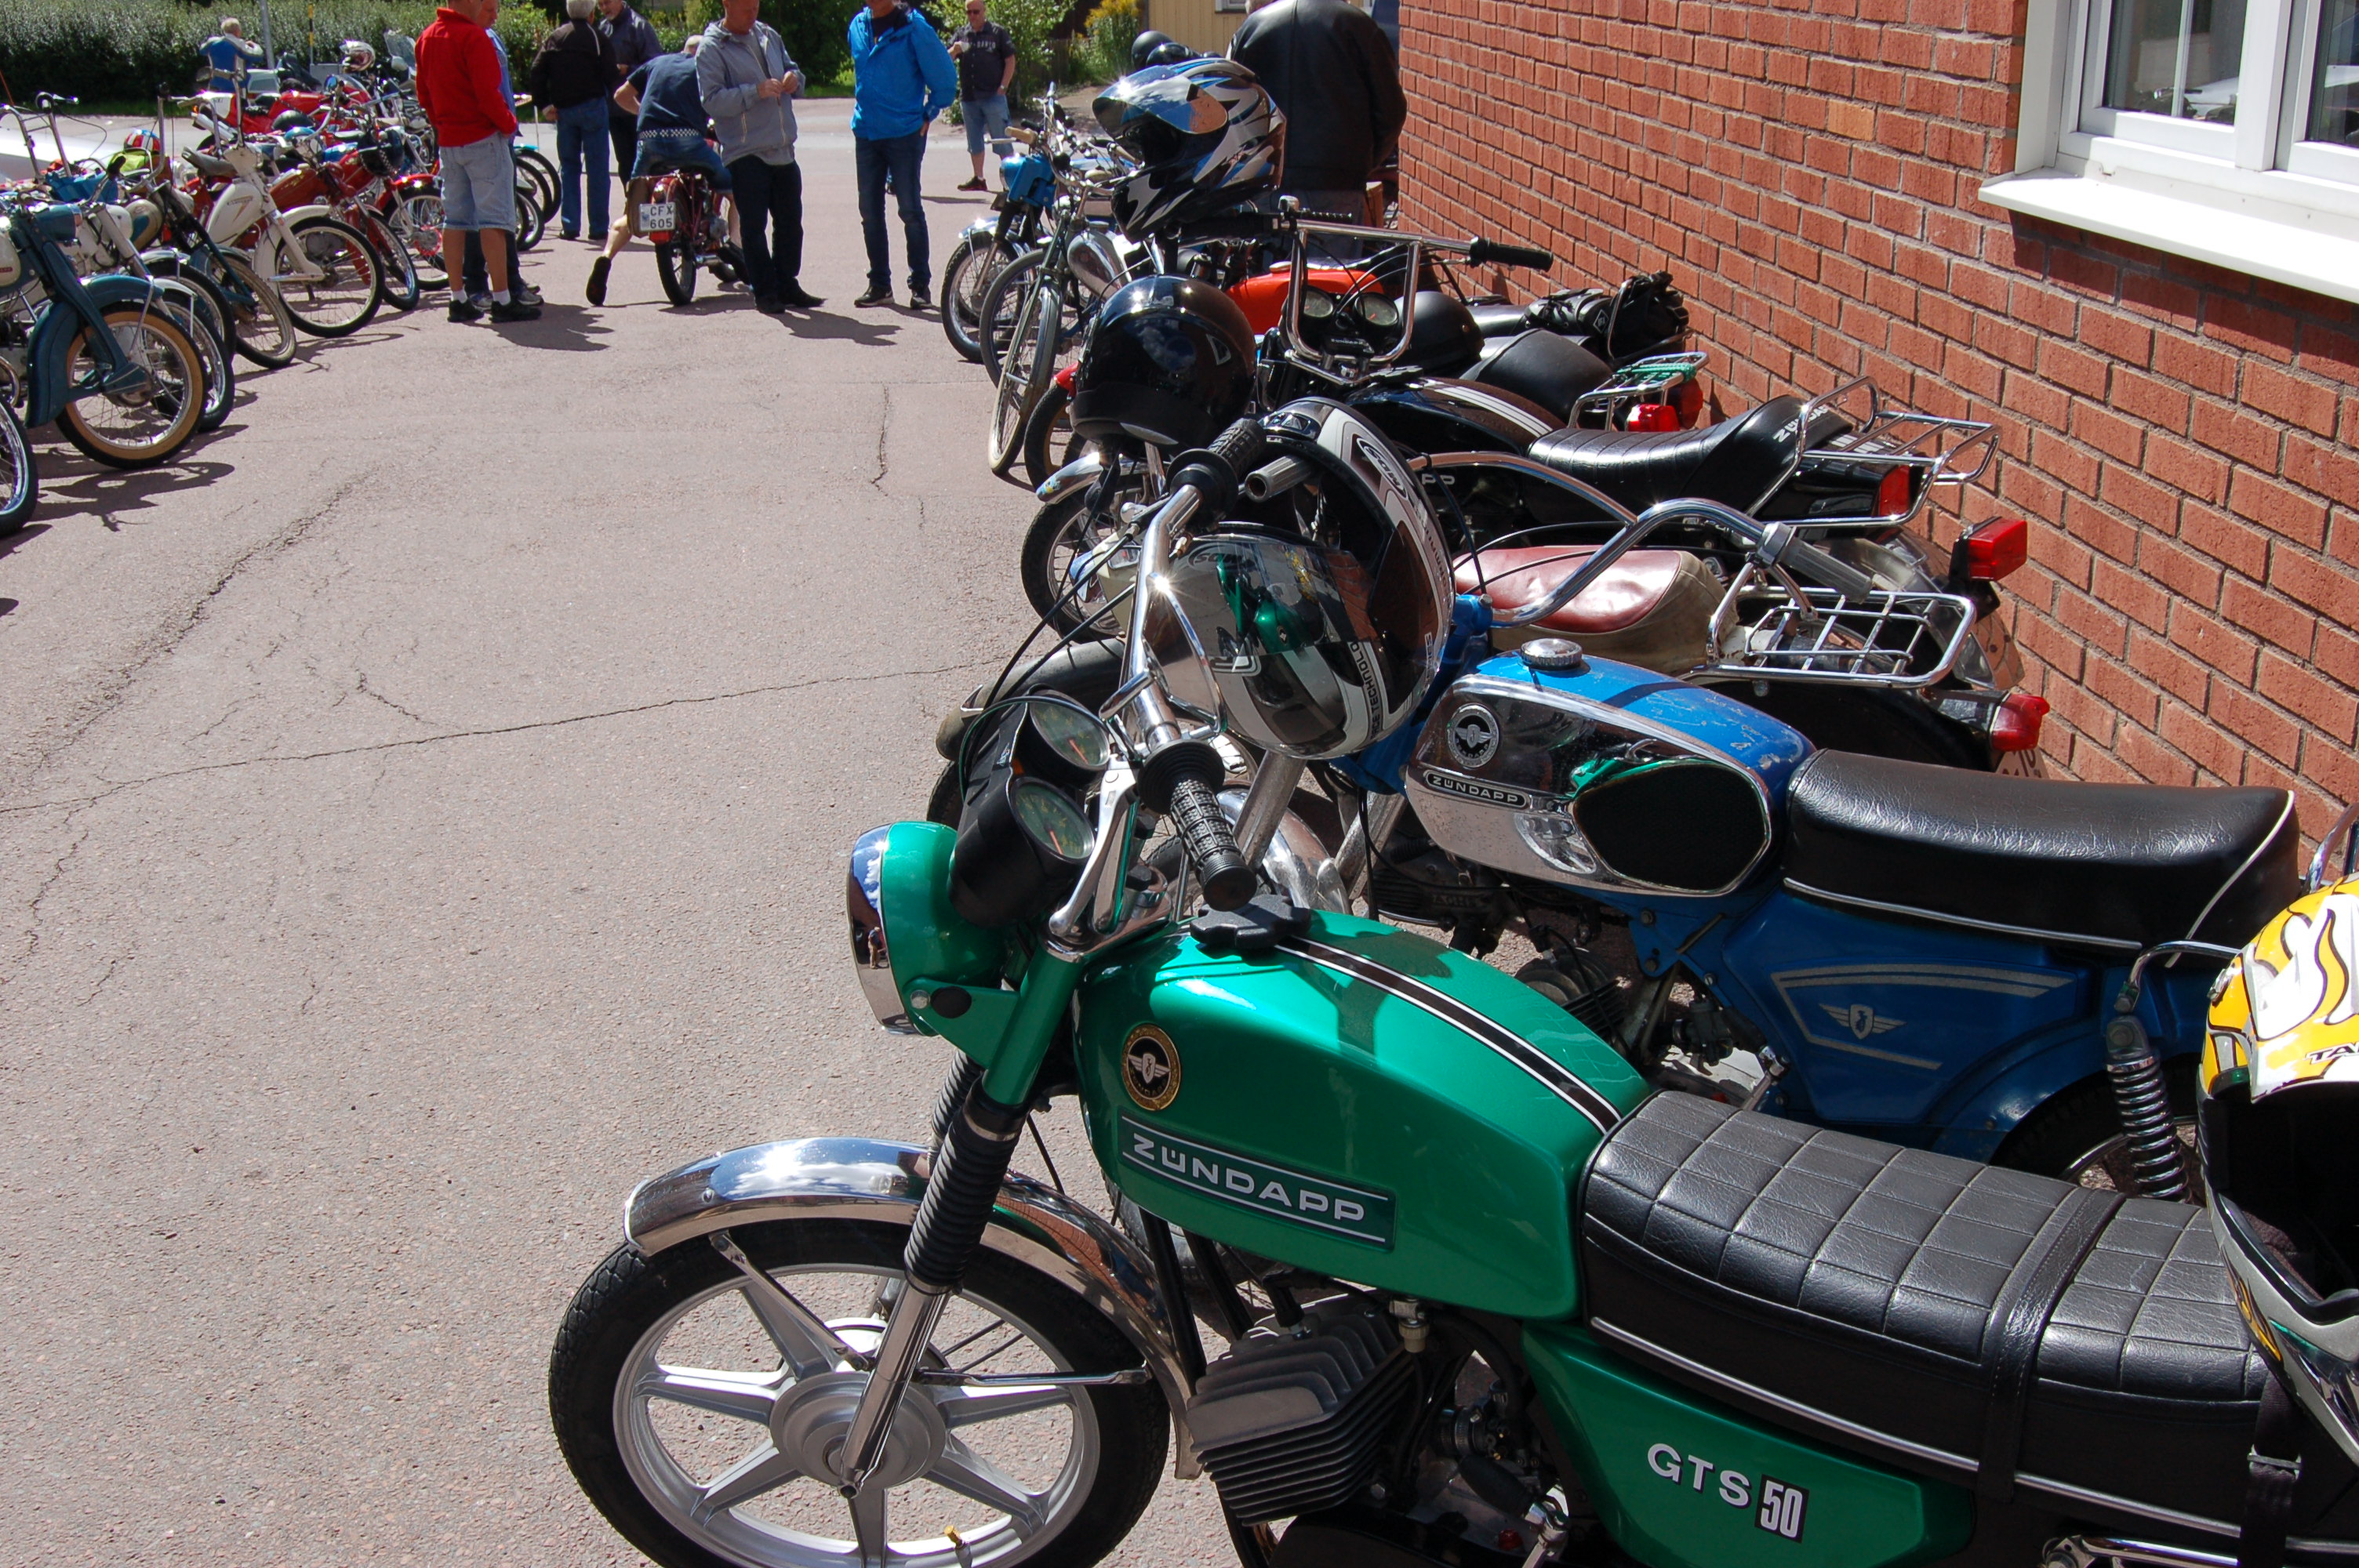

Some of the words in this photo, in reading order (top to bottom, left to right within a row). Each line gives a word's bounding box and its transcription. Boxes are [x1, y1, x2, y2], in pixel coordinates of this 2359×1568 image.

[650, 205, 673, 216] CFX
[650, 217, 673, 229] 605
[1350, 642, 1380, 713] TECHNOLO
[1432, 775, 1519, 803] ZÜNDAPP
[2306, 1043, 2359, 1063] TA
[1133, 1132, 1365, 1221] ZÜNDAPP
[1648, 1443, 1750, 1507] GTS
[1760, 1479, 1803, 1538] 50
